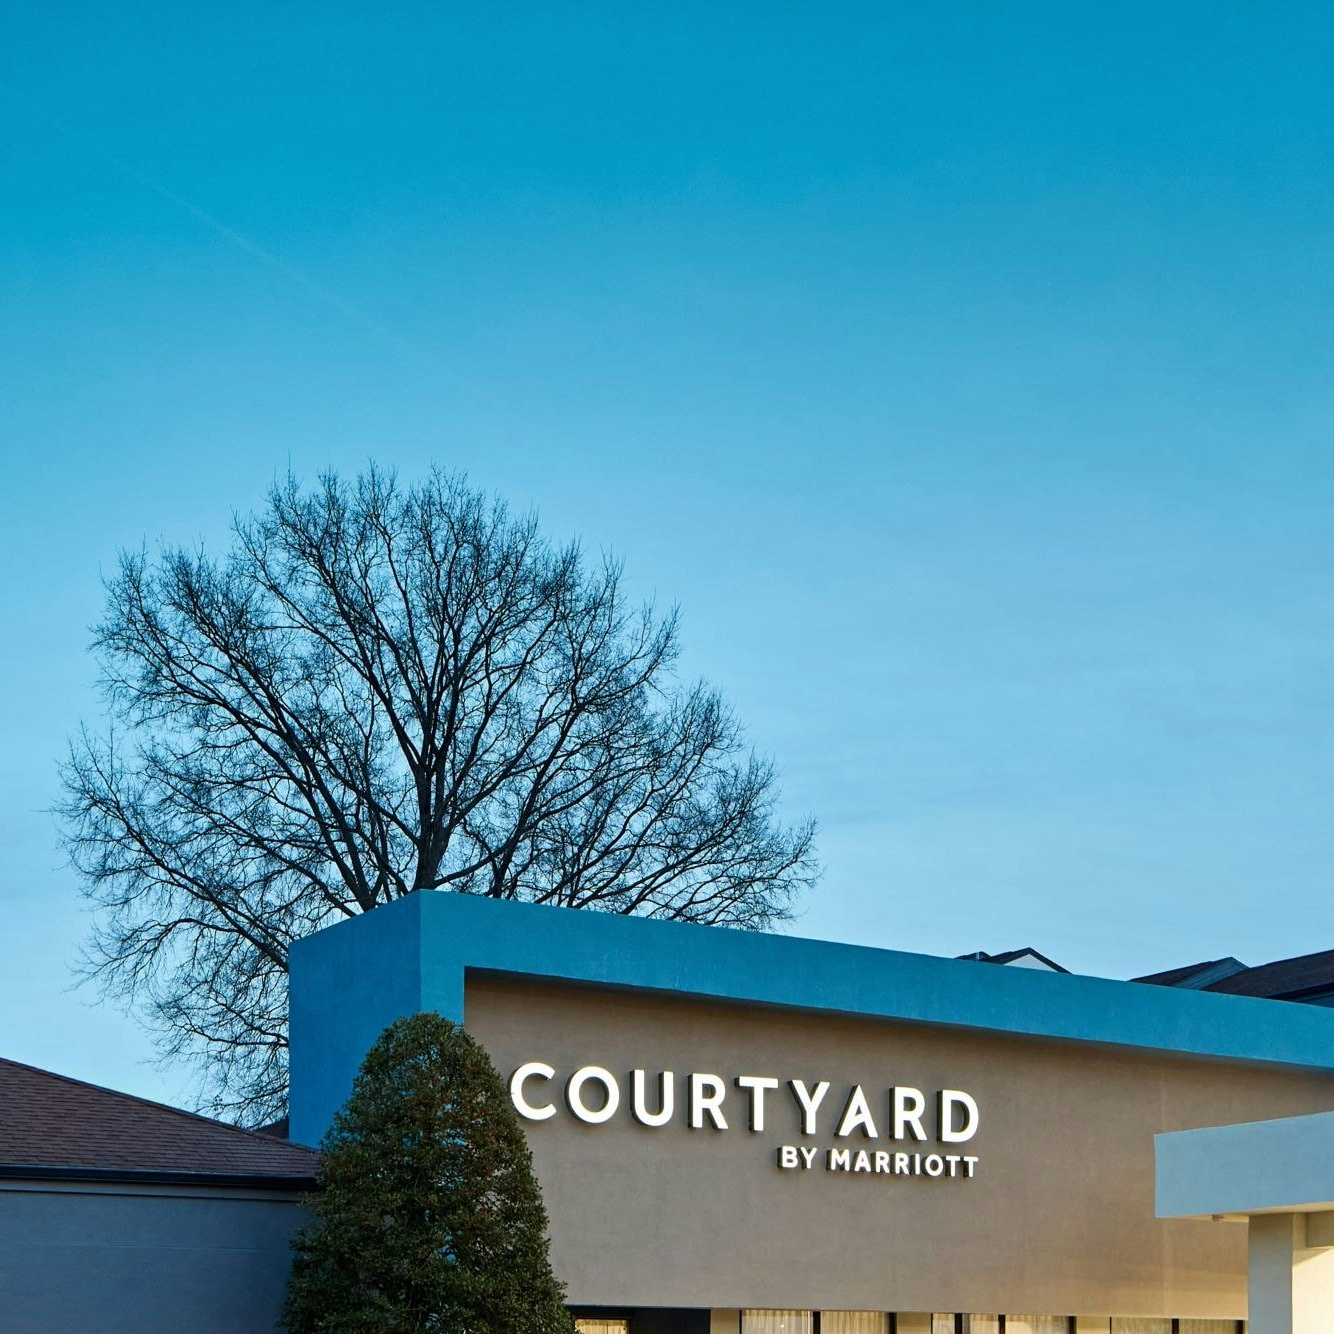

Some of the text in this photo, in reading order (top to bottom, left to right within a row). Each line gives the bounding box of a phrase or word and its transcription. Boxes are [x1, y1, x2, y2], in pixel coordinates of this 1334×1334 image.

[510, 1062, 980, 1143] COURTYARD
[781, 1145, 979, 1178] BY MARRIOTT
